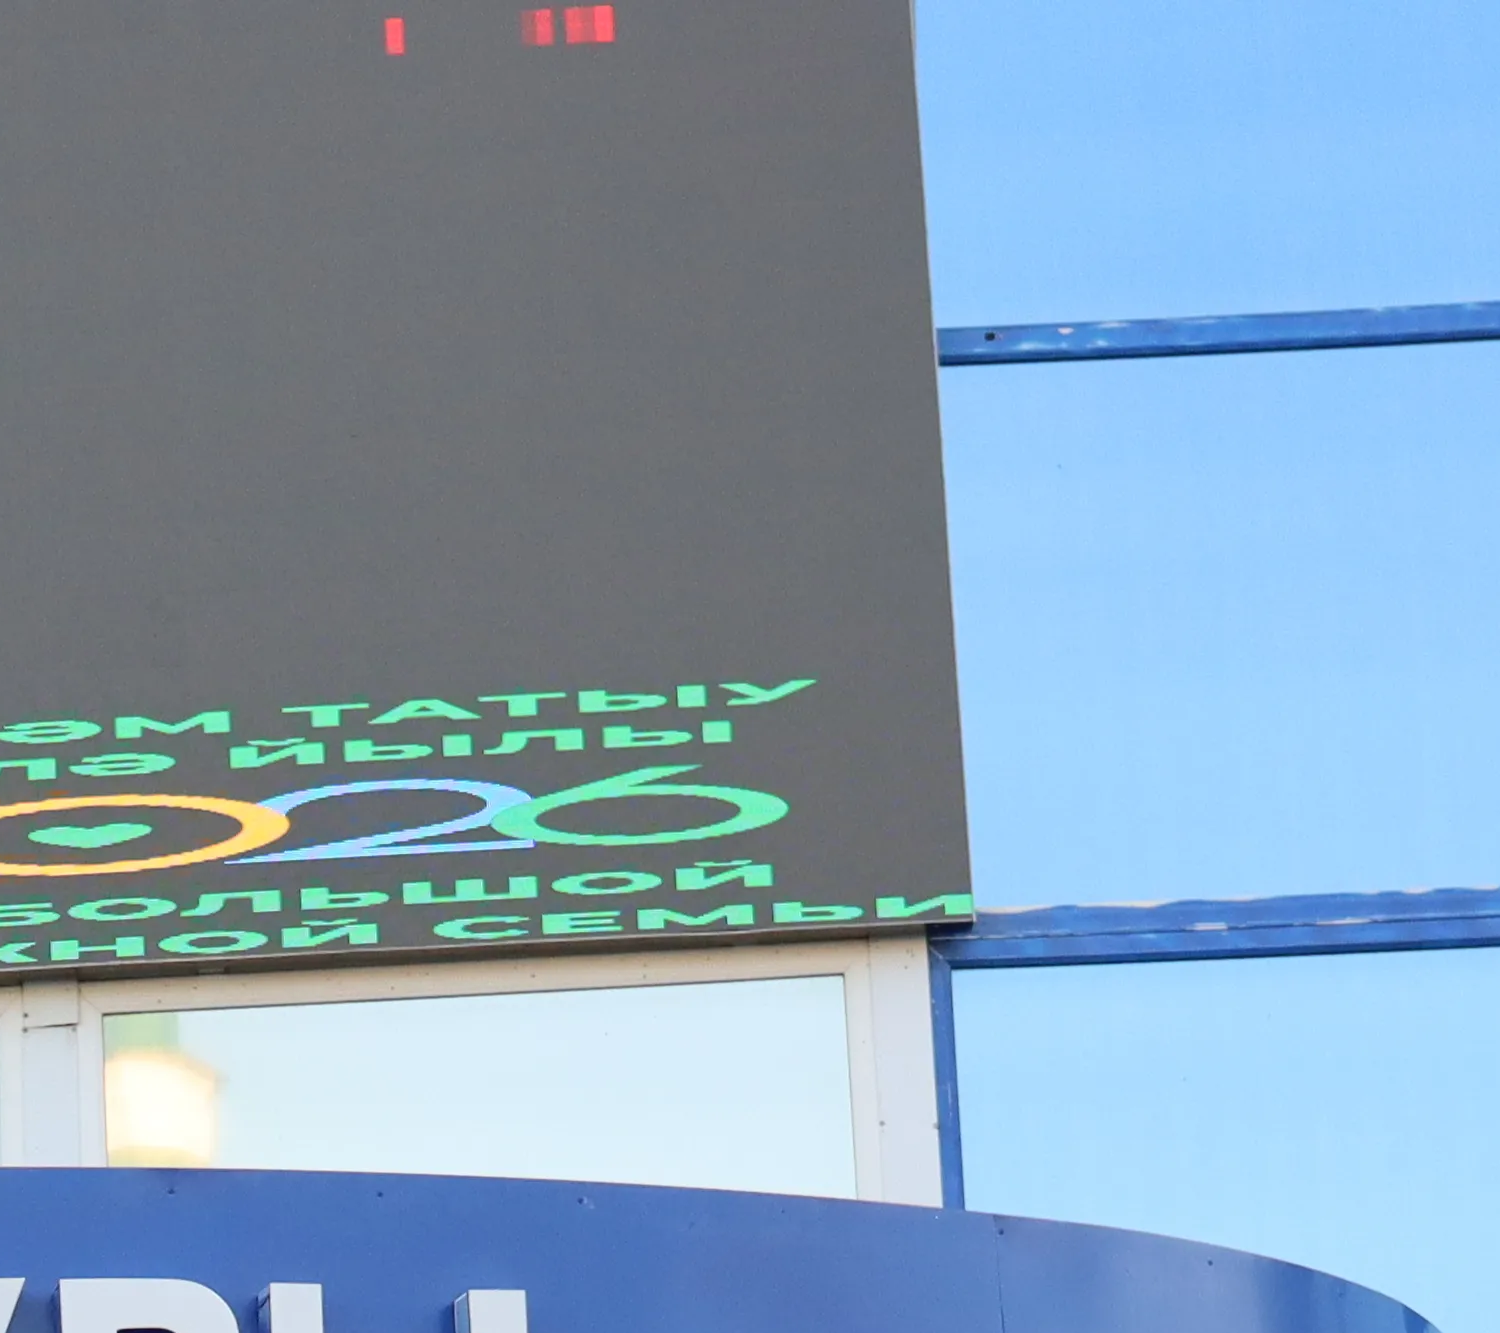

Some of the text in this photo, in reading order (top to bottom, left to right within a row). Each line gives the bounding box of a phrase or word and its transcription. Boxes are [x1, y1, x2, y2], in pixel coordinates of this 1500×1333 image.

[282, 679, 816, 727] ТАТЫУ
[230, 721, 732, 768] ЙЫЛЫ
[433, 894, 973, 939] СЕМЬИ
